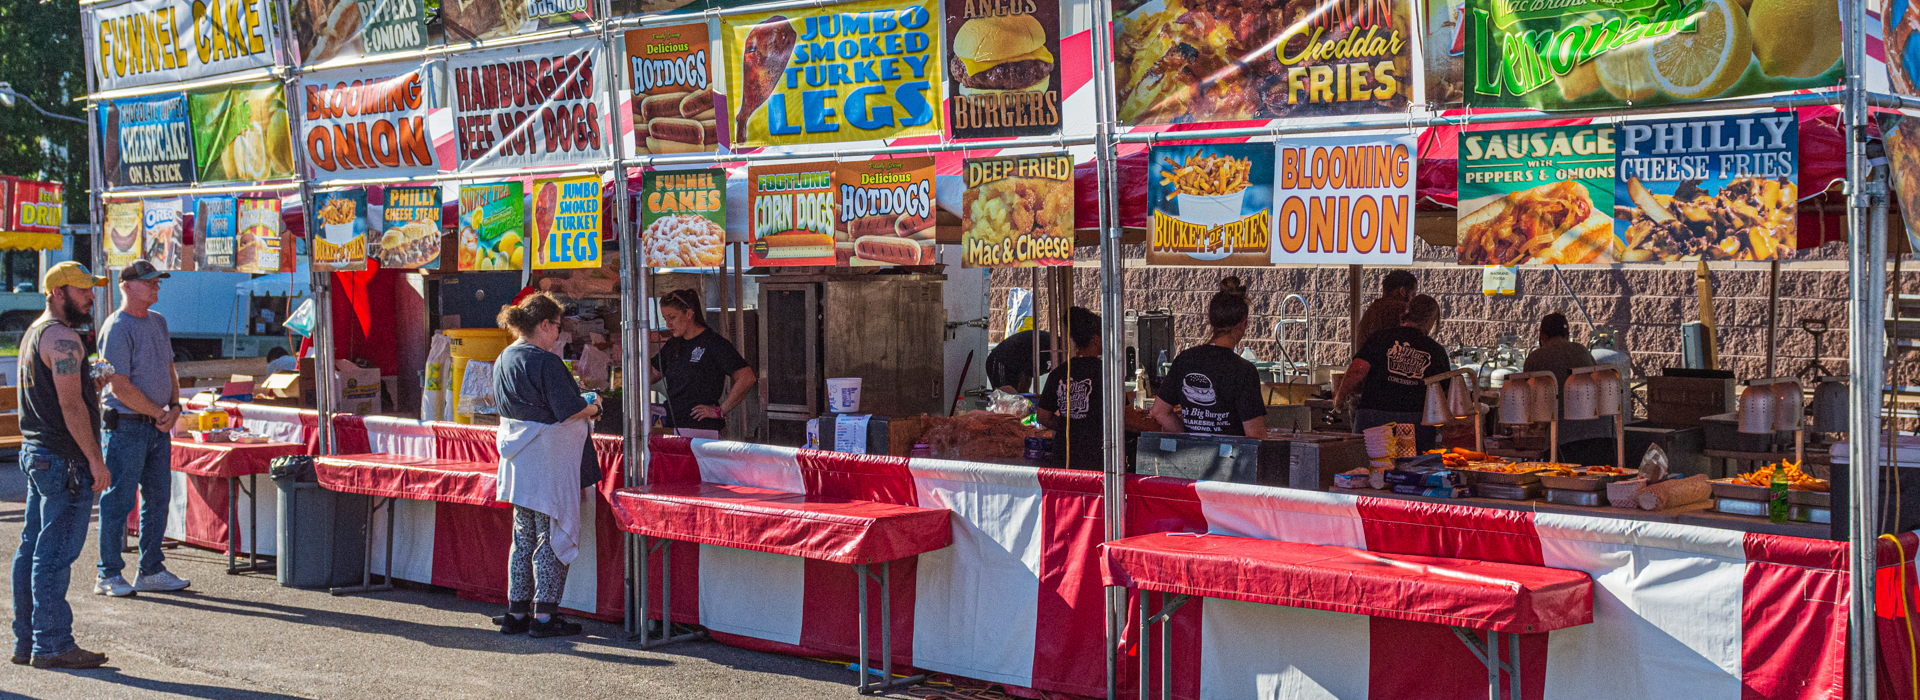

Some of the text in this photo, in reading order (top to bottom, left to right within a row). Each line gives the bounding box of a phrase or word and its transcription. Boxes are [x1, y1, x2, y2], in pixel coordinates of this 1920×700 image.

[100, 0, 266, 78] FUNNEL CAKE
[372, 21, 420, 52] ONIONS
[801, 5, 929, 41] JUMBO
[646, 43, 689, 55] Delicious
[794, 31, 930, 64] SMOKED
[1276, 22, 1406, 66] Cheddar
[1474, 0, 1708, 97] Lemonade
[455, 51, 594, 112] HAMBURGERS
[631, 50, 707, 95] HOTDOGS
[785, 54, 930, 89] TURKEY
[1287, 60, 1397, 105] FRIES
[121, 101, 158, 124] CHOCOLATE
[305, 72, 422, 121] BLOOMING
[767, 81, 933, 136] LEGS
[954, 91, 1059, 130] BURGERS
[120, 122, 189, 164] CHEESECAKE
[307, 116, 433, 172] ONION
[457, 102, 602, 161] BEEF HOT DOGS
[1465, 128, 1616, 161] SAUSAGE
[1621, 116, 1791, 156] PHILLY
[129, 164, 183, 184] ON A STICK
[860, 172, 911, 185] Delicious
[969, 156, 1070, 189] DEEP FRIED
[1281, 144, 1409, 190] BLOOMING
[1465, 165, 1616, 184] PEPPERS & ONIONS
[1527, 159, 1553, 168] WITH
[1620, 151, 1793, 183] CHEESE FRIES
[562, 182, 599, 199] JUMBO
[655, 173, 716, 192] FUNNEL
[758, 171, 831, 192] FOOTLONG
[390, 189, 437, 207] PHILLY
[461, 186, 491, 215] SWEET
[492, 185, 511, 202] TEA
[560, 199, 598, 214] SMOKED
[647, 190, 721, 213] CAKES
[840, 180, 930, 222] HOTDOGS
[21, 201, 62, 228] DRIN
[145, 208, 174, 229] OREO
[385, 208, 440, 221] CHEESE STEAK
[556, 214, 598, 231] TURKEY
[754, 192, 836, 238] CORN DOGS
[1153, 208, 1269, 251] BUCKET OF FRIES
[1279, 194, 1409, 254] ONION
[315, 234, 339, 261] BUCKET
[345, 232, 365, 260] FRIES
[549, 231, 598, 262] LEGS
[969, 234, 1069, 265] Mac & Cheese
[1188, 419, 1215, 427] LAKESIDE
[1190, 407, 1205, 420] Big
[1205, 409, 1230, 421] Burger
